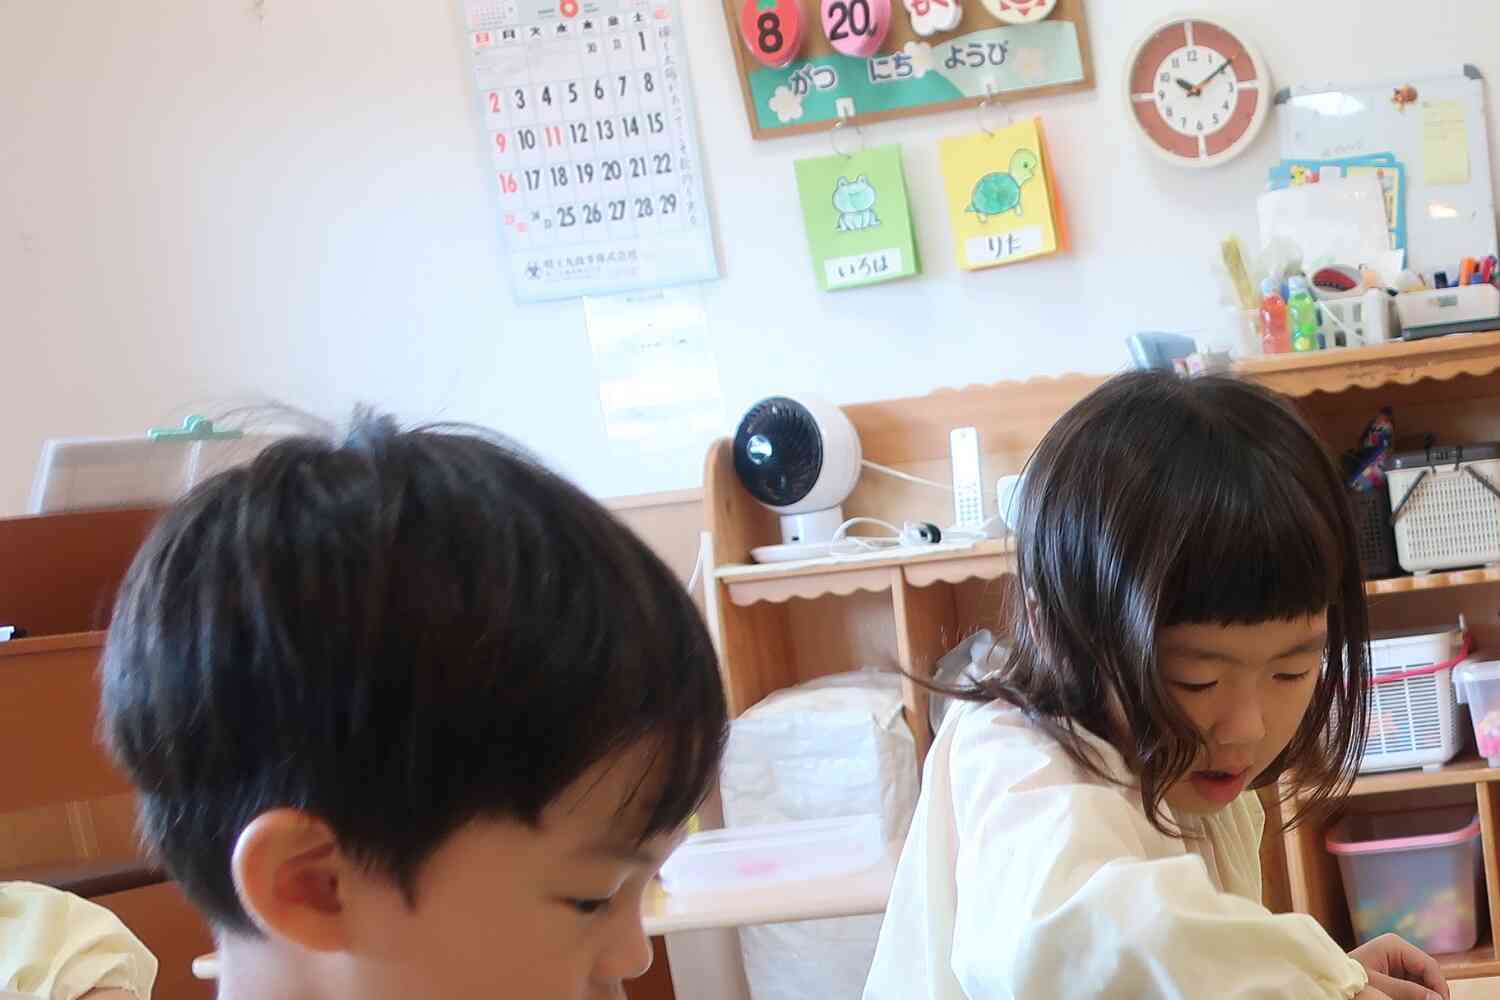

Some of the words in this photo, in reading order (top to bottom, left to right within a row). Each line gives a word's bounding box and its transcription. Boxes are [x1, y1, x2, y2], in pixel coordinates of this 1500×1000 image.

[638, 31, 646, 51] 1
[757, 12, 784, 53] 8
[828, 0, 871, 41] 20
[790, 66, 837, 96] がつ
[869, 51, 914, 81] にち
[944, 40, 1009, 69] ようび
[489, 92, 501, 113] 2
[515, 89, 526, 109] 3
[541, 86, 552, 106] 4
[568, 83, 578, 103] 5
[593, 79, 604, 100] 6
[618, 76, 627, 97] 7
[644, 72, 654, 93] 8
[495, 132, 507, 153] 9
[518, 128, 536, 150] 10
[545, 127, 562, 148] 11
[570, 123, 587, 144] 12
[596, 120, 614, 141] 13
[622, 116, 640, 137] 14
[648, 113, 663, 134] 15
[500, 172, 518, 194] 16
[525, 169, 541, 191] 17
[551, 166, 568, 187] 18
[576, 163, 593, 184] 19
[602, 159, 621, 181] 20
[629, 157, 647, 178] 21
[653, 153, 673, 175] 22
[557, 206, 576, 227] 25
[583, 203, 602, 224] 26
[608, 200, 627, 221] 27
[635, 197, 653, 218] 28
[660, 193, 677, 214] 29
[988, 234, 1022, 258] りた
[838, 258, 888, 279] いろは
